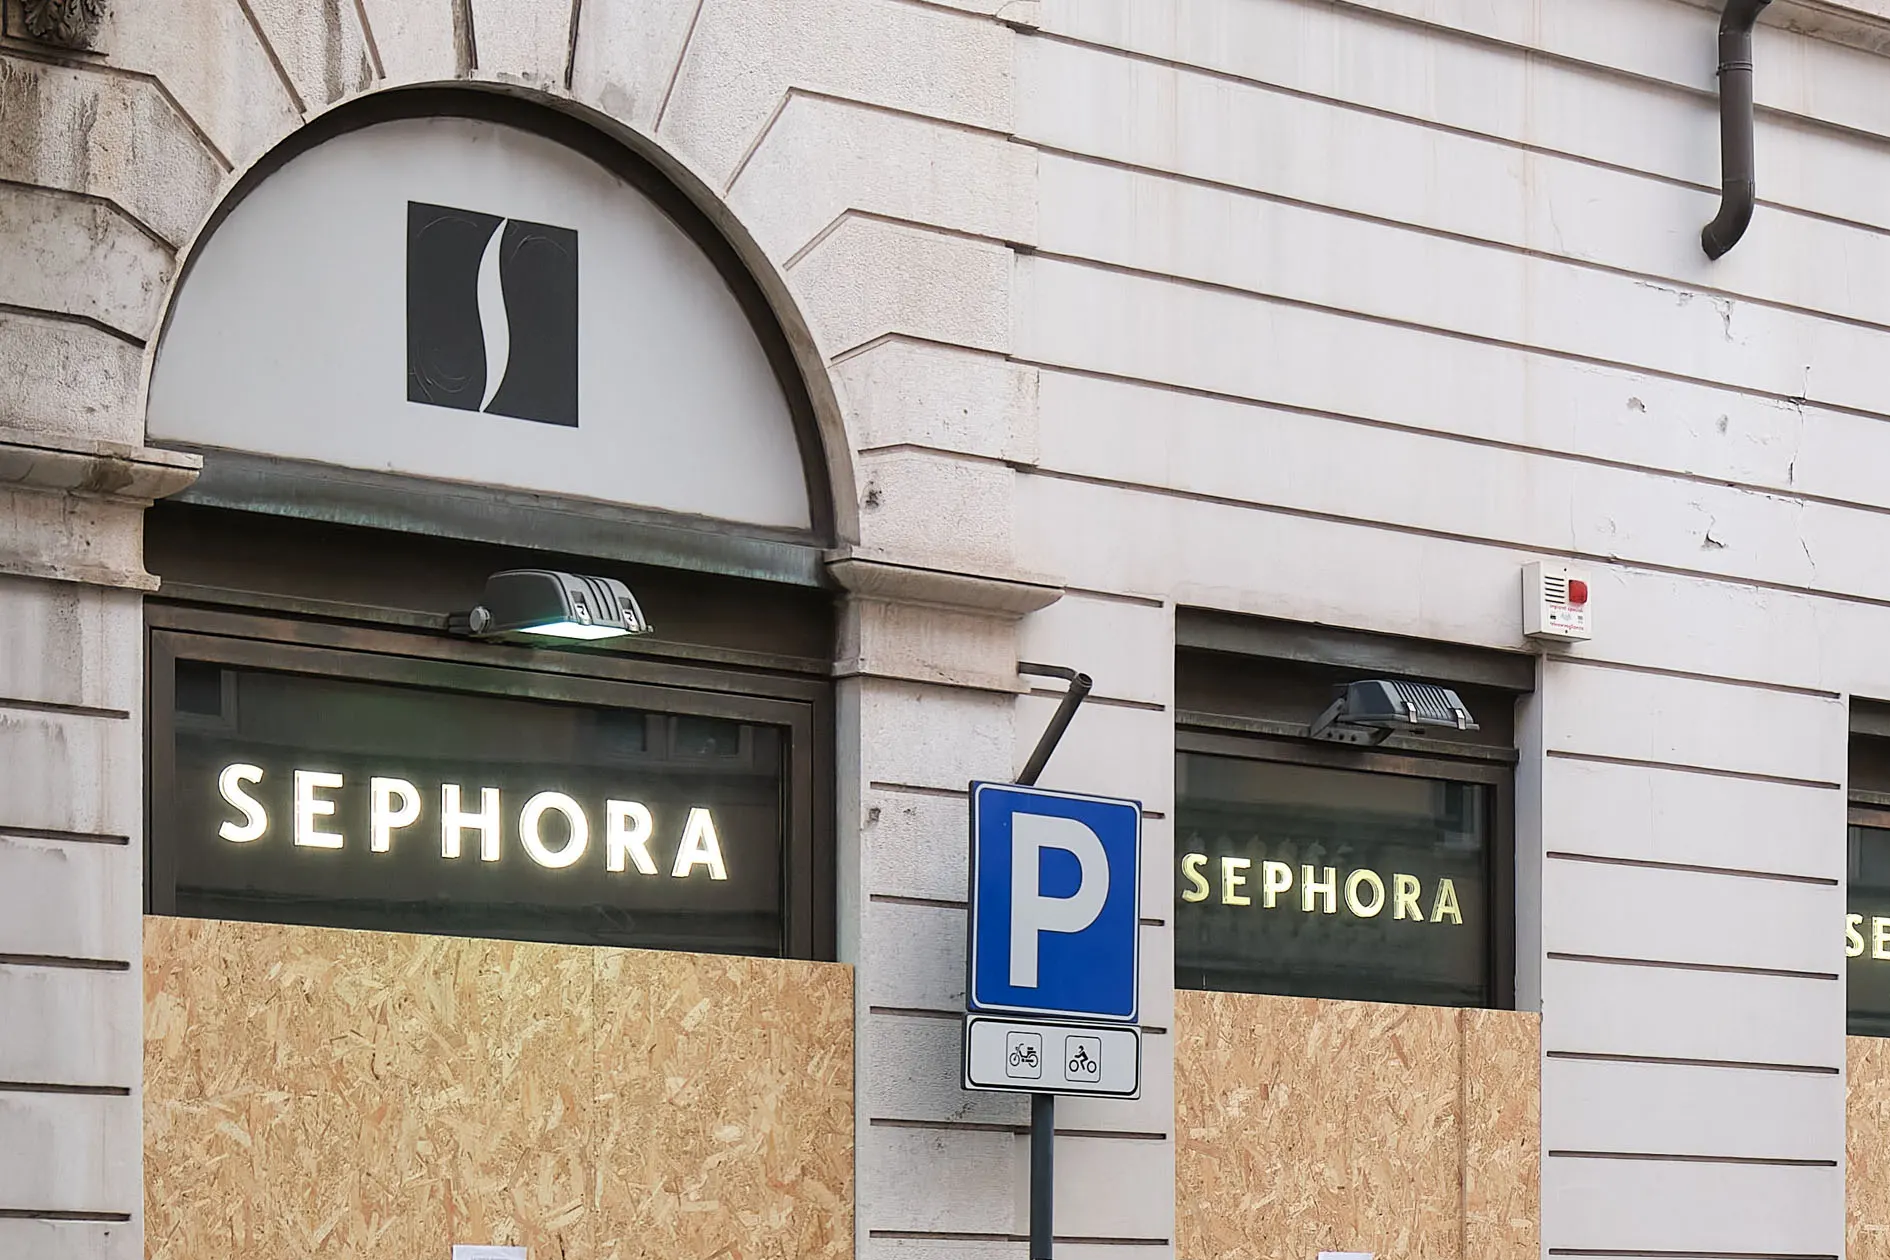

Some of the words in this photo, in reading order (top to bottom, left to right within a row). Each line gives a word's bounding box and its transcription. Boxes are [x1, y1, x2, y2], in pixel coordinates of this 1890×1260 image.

[217, 763, 728, 881] SEPHORA
[1010, 812, 1110, 988] P
[1181, 853, 1463, 925] SEPHORA
